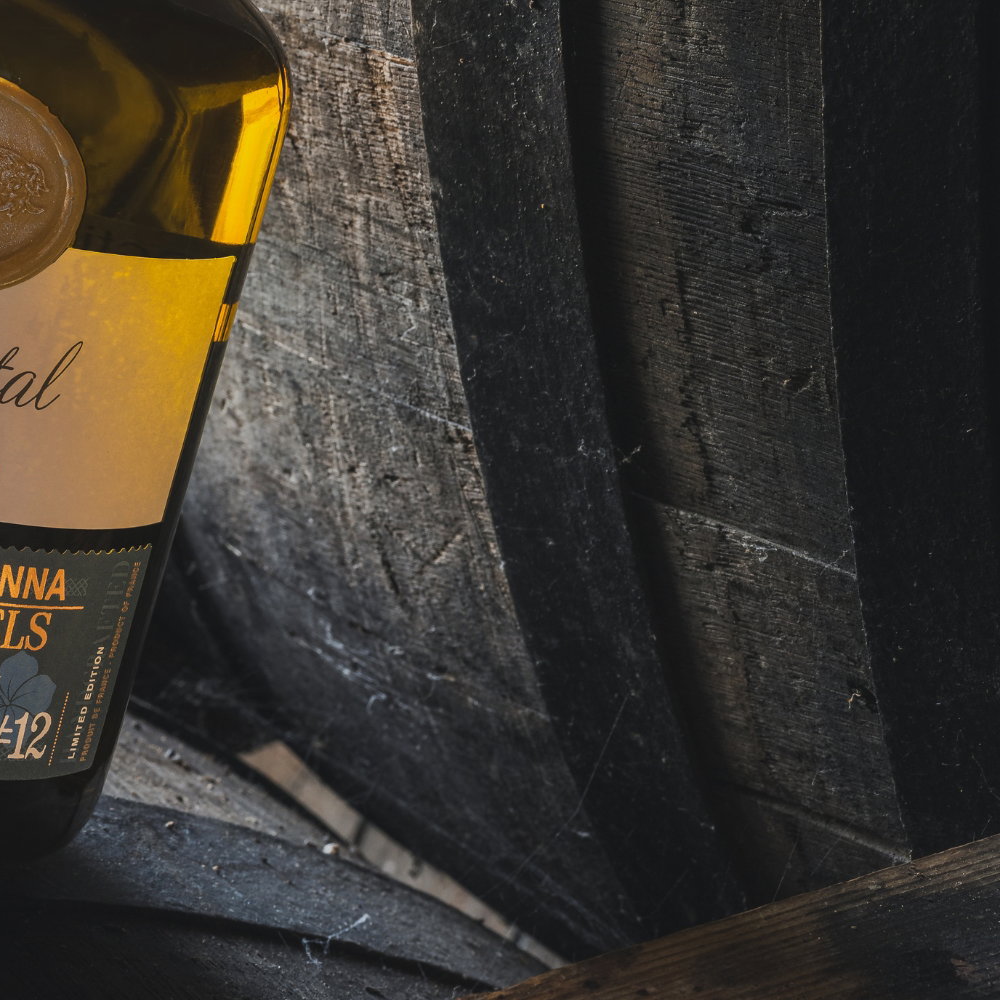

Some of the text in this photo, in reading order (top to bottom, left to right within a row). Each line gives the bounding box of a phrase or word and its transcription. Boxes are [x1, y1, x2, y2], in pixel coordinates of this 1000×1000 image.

[125, 562, 141, 598] FRANCE
[121, 601, 130, 613] OF
[108, 616, 126, 658] PRODUCT
[68, 646, 105, 759] LIMITED EDITION
[96, 668, 111, 705] FRANCE
[92, 707, 100, 719] DE
